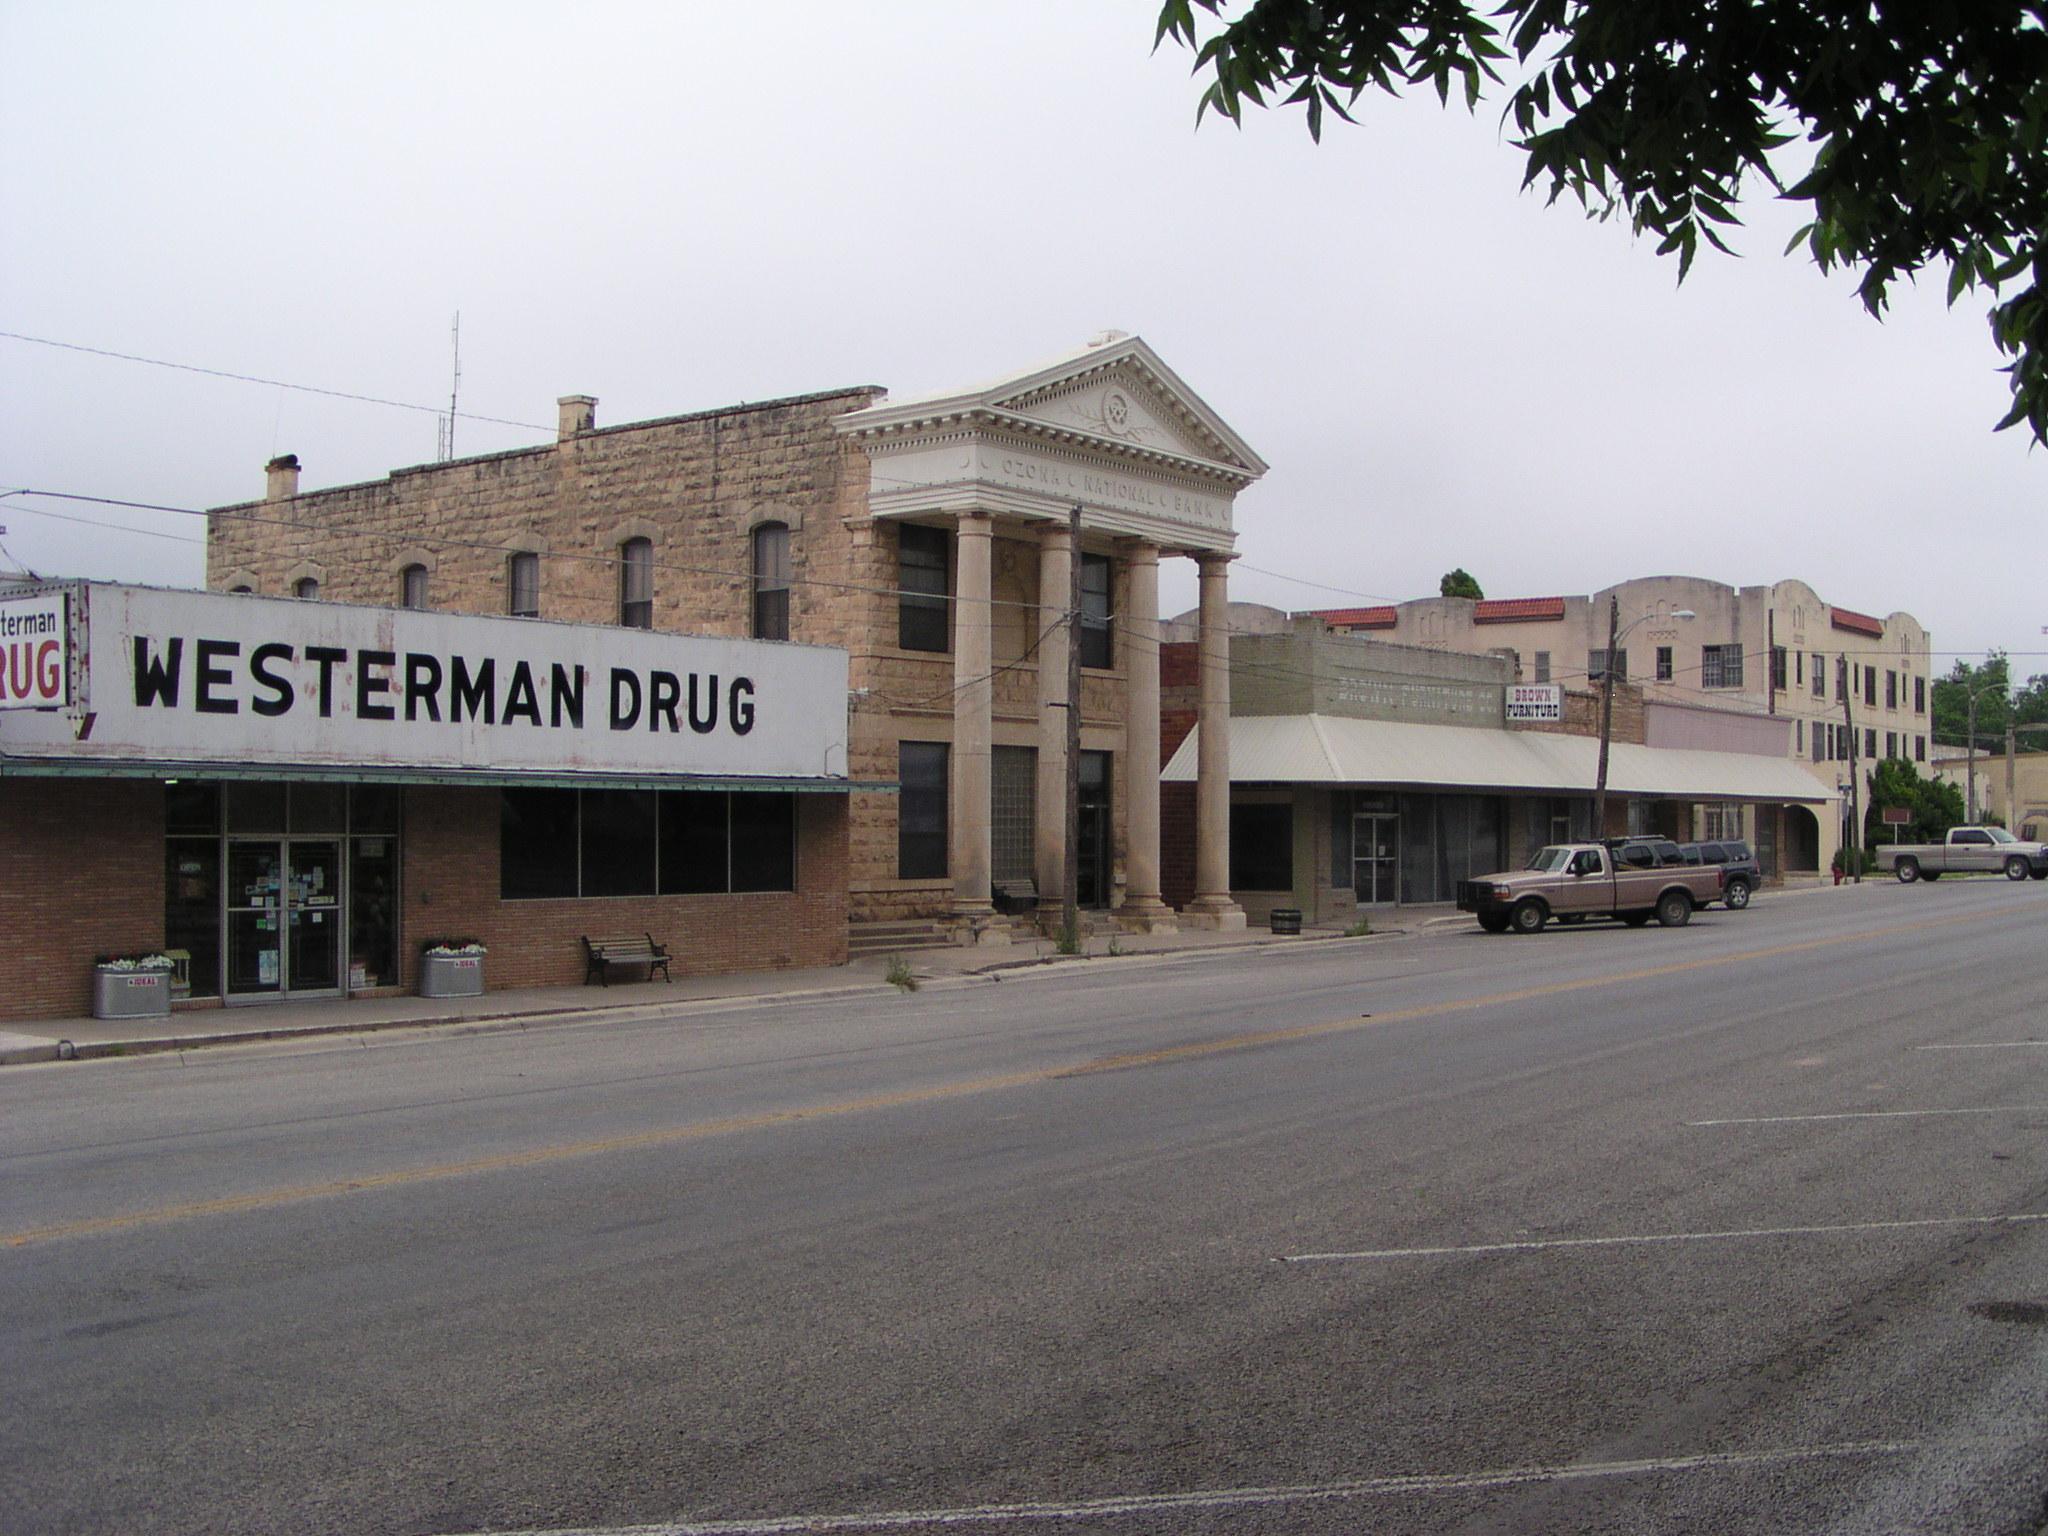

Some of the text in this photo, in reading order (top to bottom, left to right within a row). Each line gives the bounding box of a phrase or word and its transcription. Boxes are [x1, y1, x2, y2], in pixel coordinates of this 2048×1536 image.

[1084, 474, 1155, 506] NATIONAL
[1174, 494, 1213, 519] BANK
[133, 635, 755, 736] WESTERMAN DRUG
[1515, 688, 1552, 702] BROWN
[1507, 703, 1558, 717] FURNITURE
